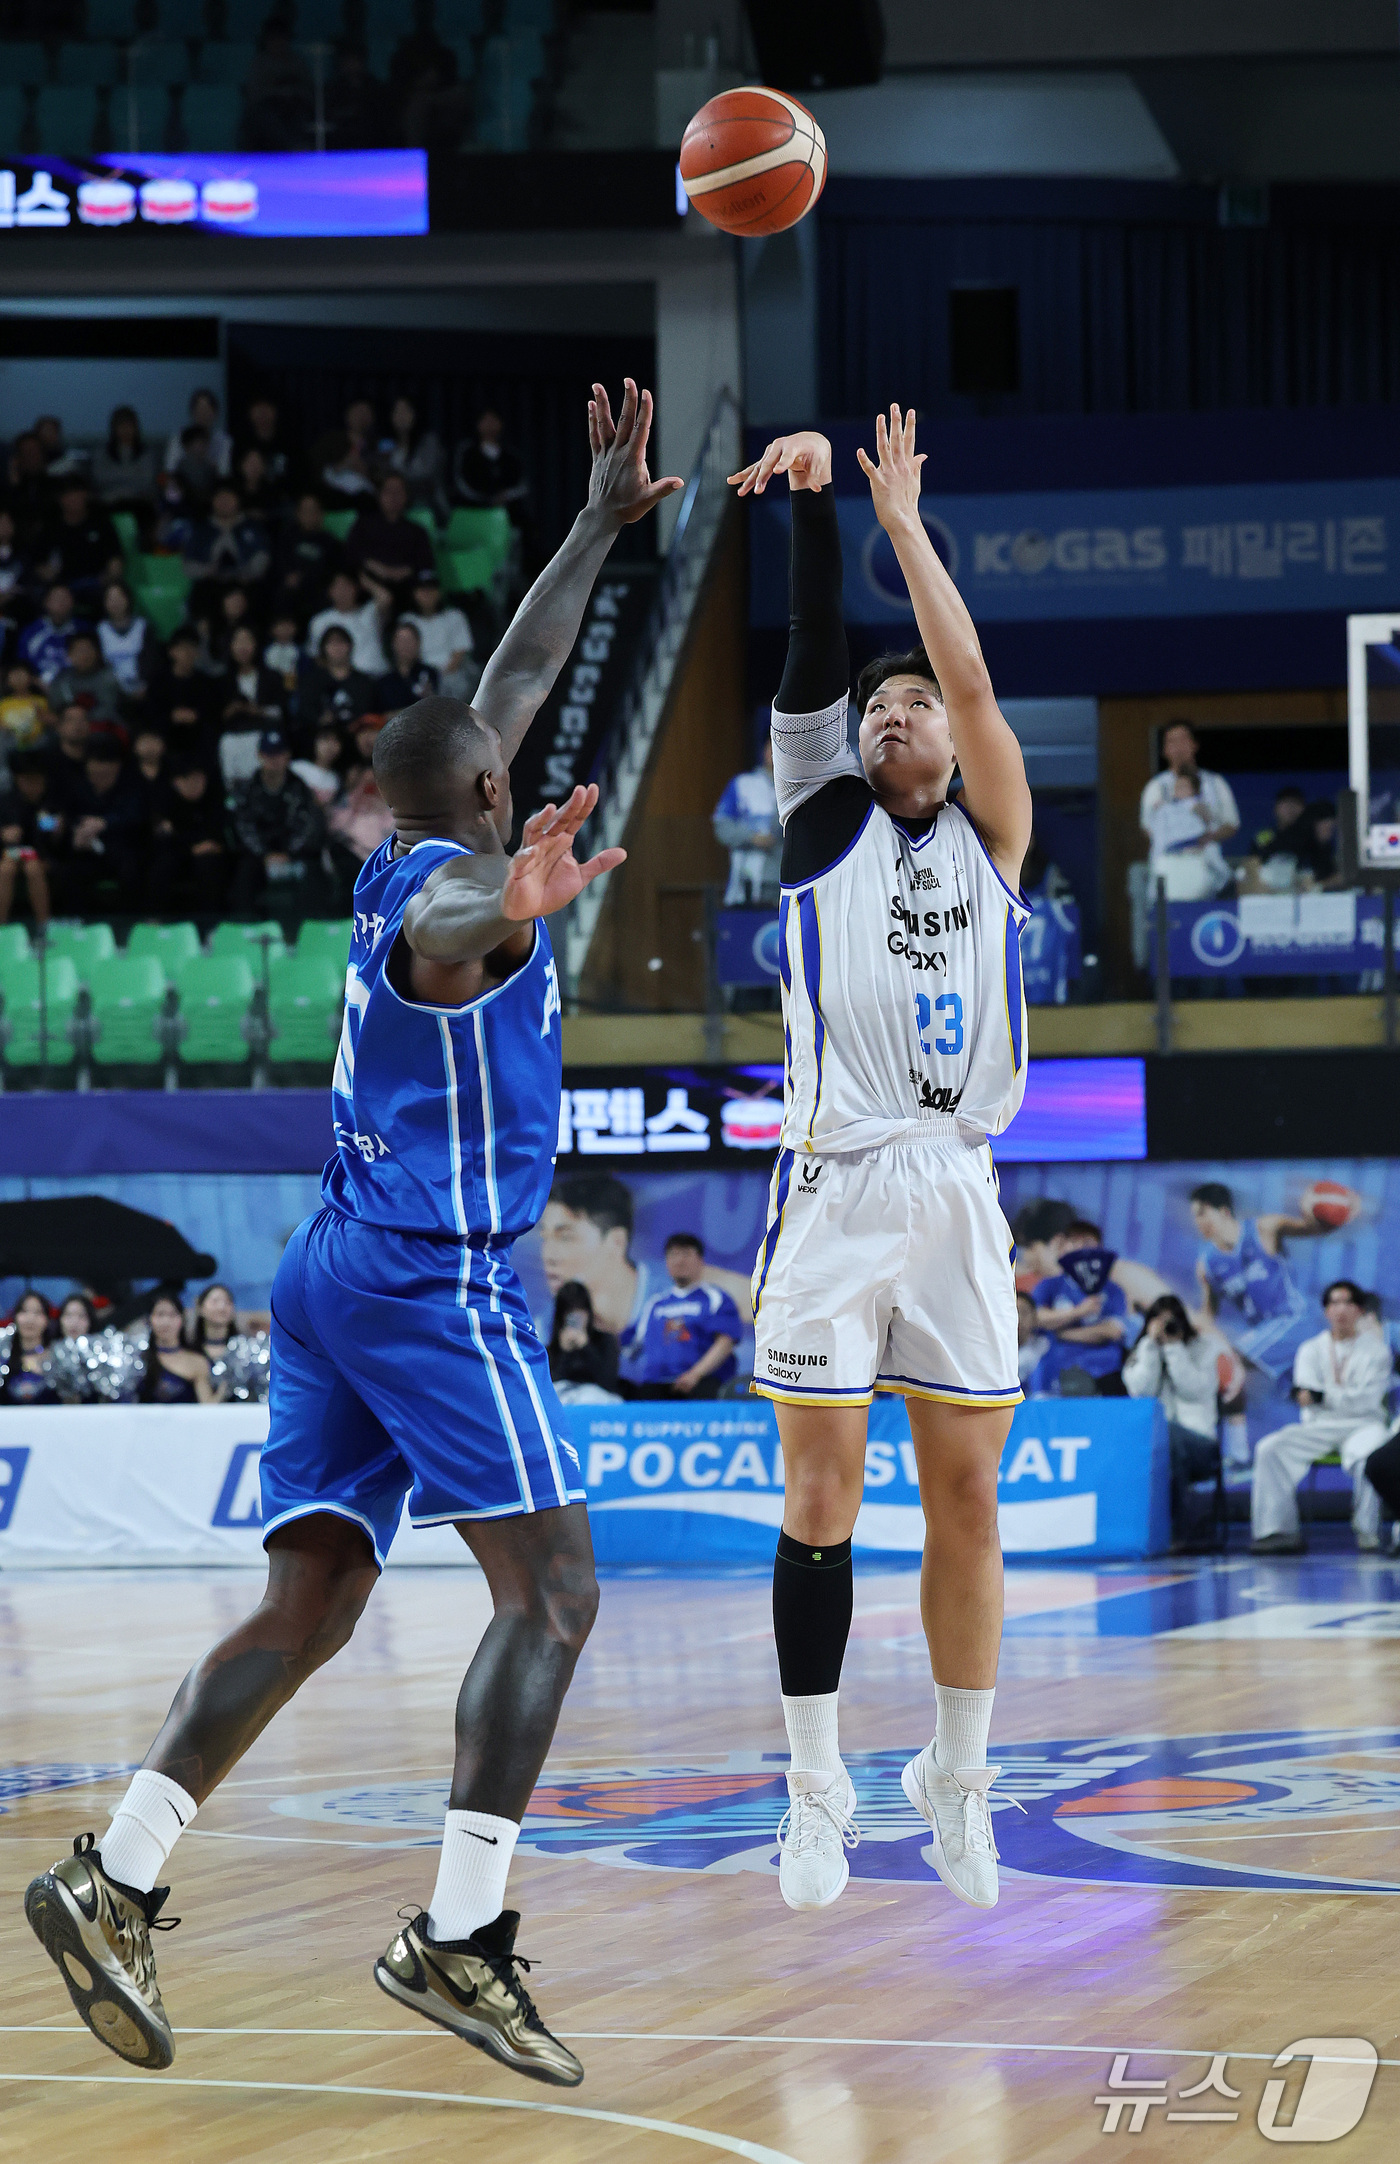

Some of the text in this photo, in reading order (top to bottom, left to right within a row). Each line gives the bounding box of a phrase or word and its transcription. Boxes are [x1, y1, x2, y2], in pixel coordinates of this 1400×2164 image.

[1181, 516, 1387, 579] 패밀리존
[915, 992, 963, 1055] 23
[767, 1348, 828, 1366] SAMSUNG
[767, 1364, 802, 1383] Galaxy
[585, 1436, 1092, 1488] POCA SAT
